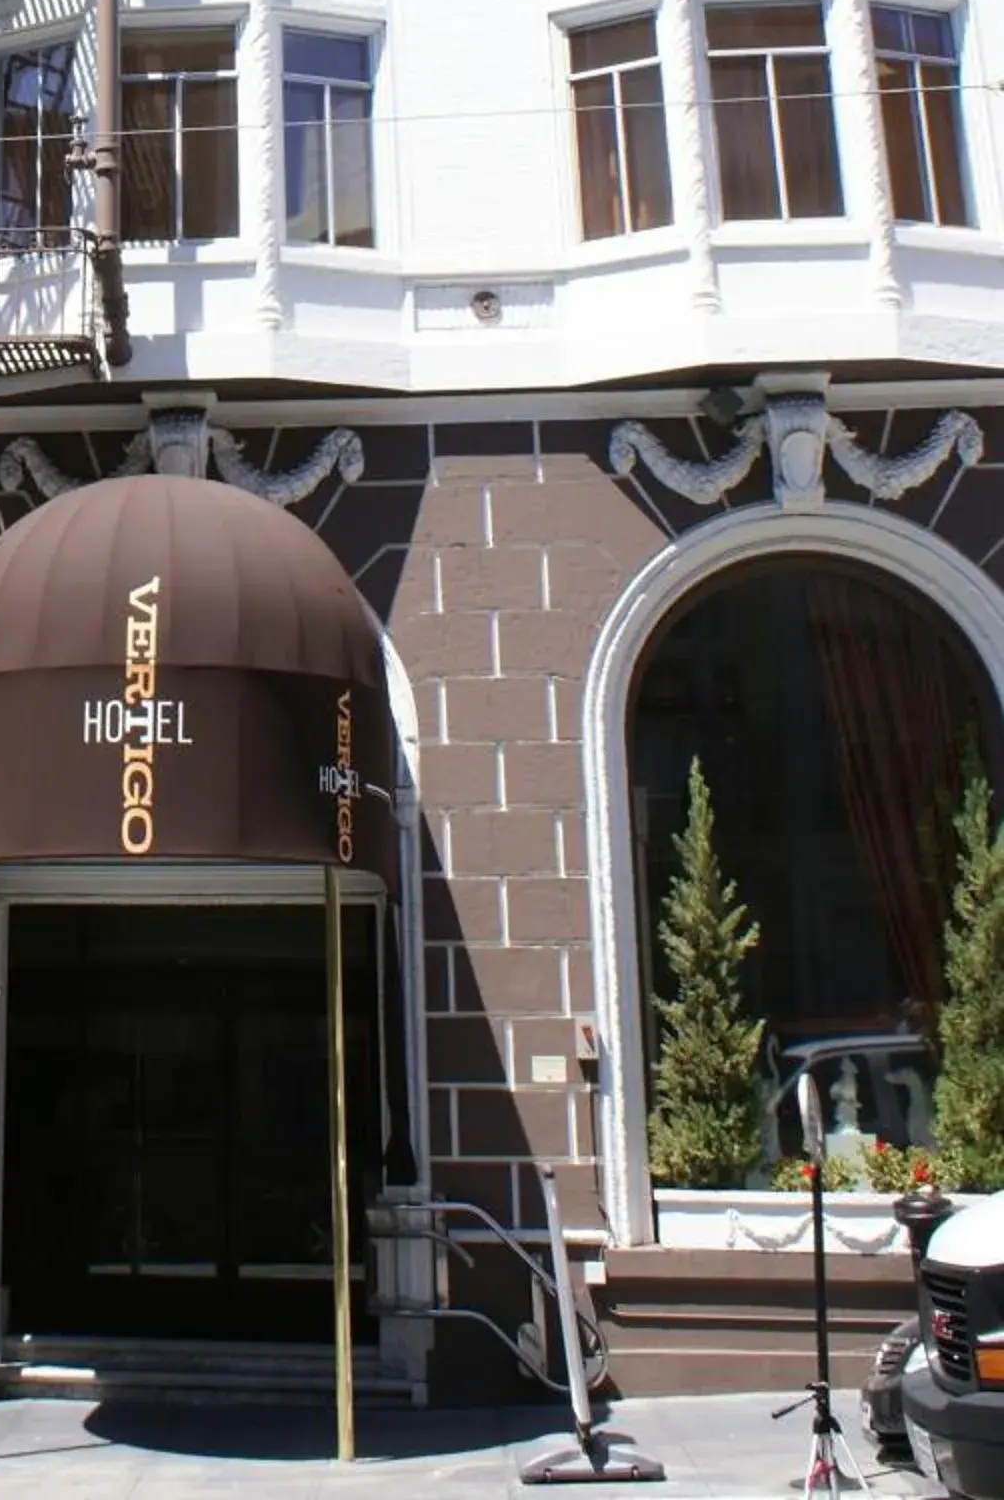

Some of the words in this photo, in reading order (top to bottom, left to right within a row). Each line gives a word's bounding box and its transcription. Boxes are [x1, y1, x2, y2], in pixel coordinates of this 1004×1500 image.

[83, 700, 193, 744] HOTEL
[121, 575, 160, 854] VERTIGO
[318, 765, 362, 798] HOTEL
[337, 690, 353, 863] VERTIGO
